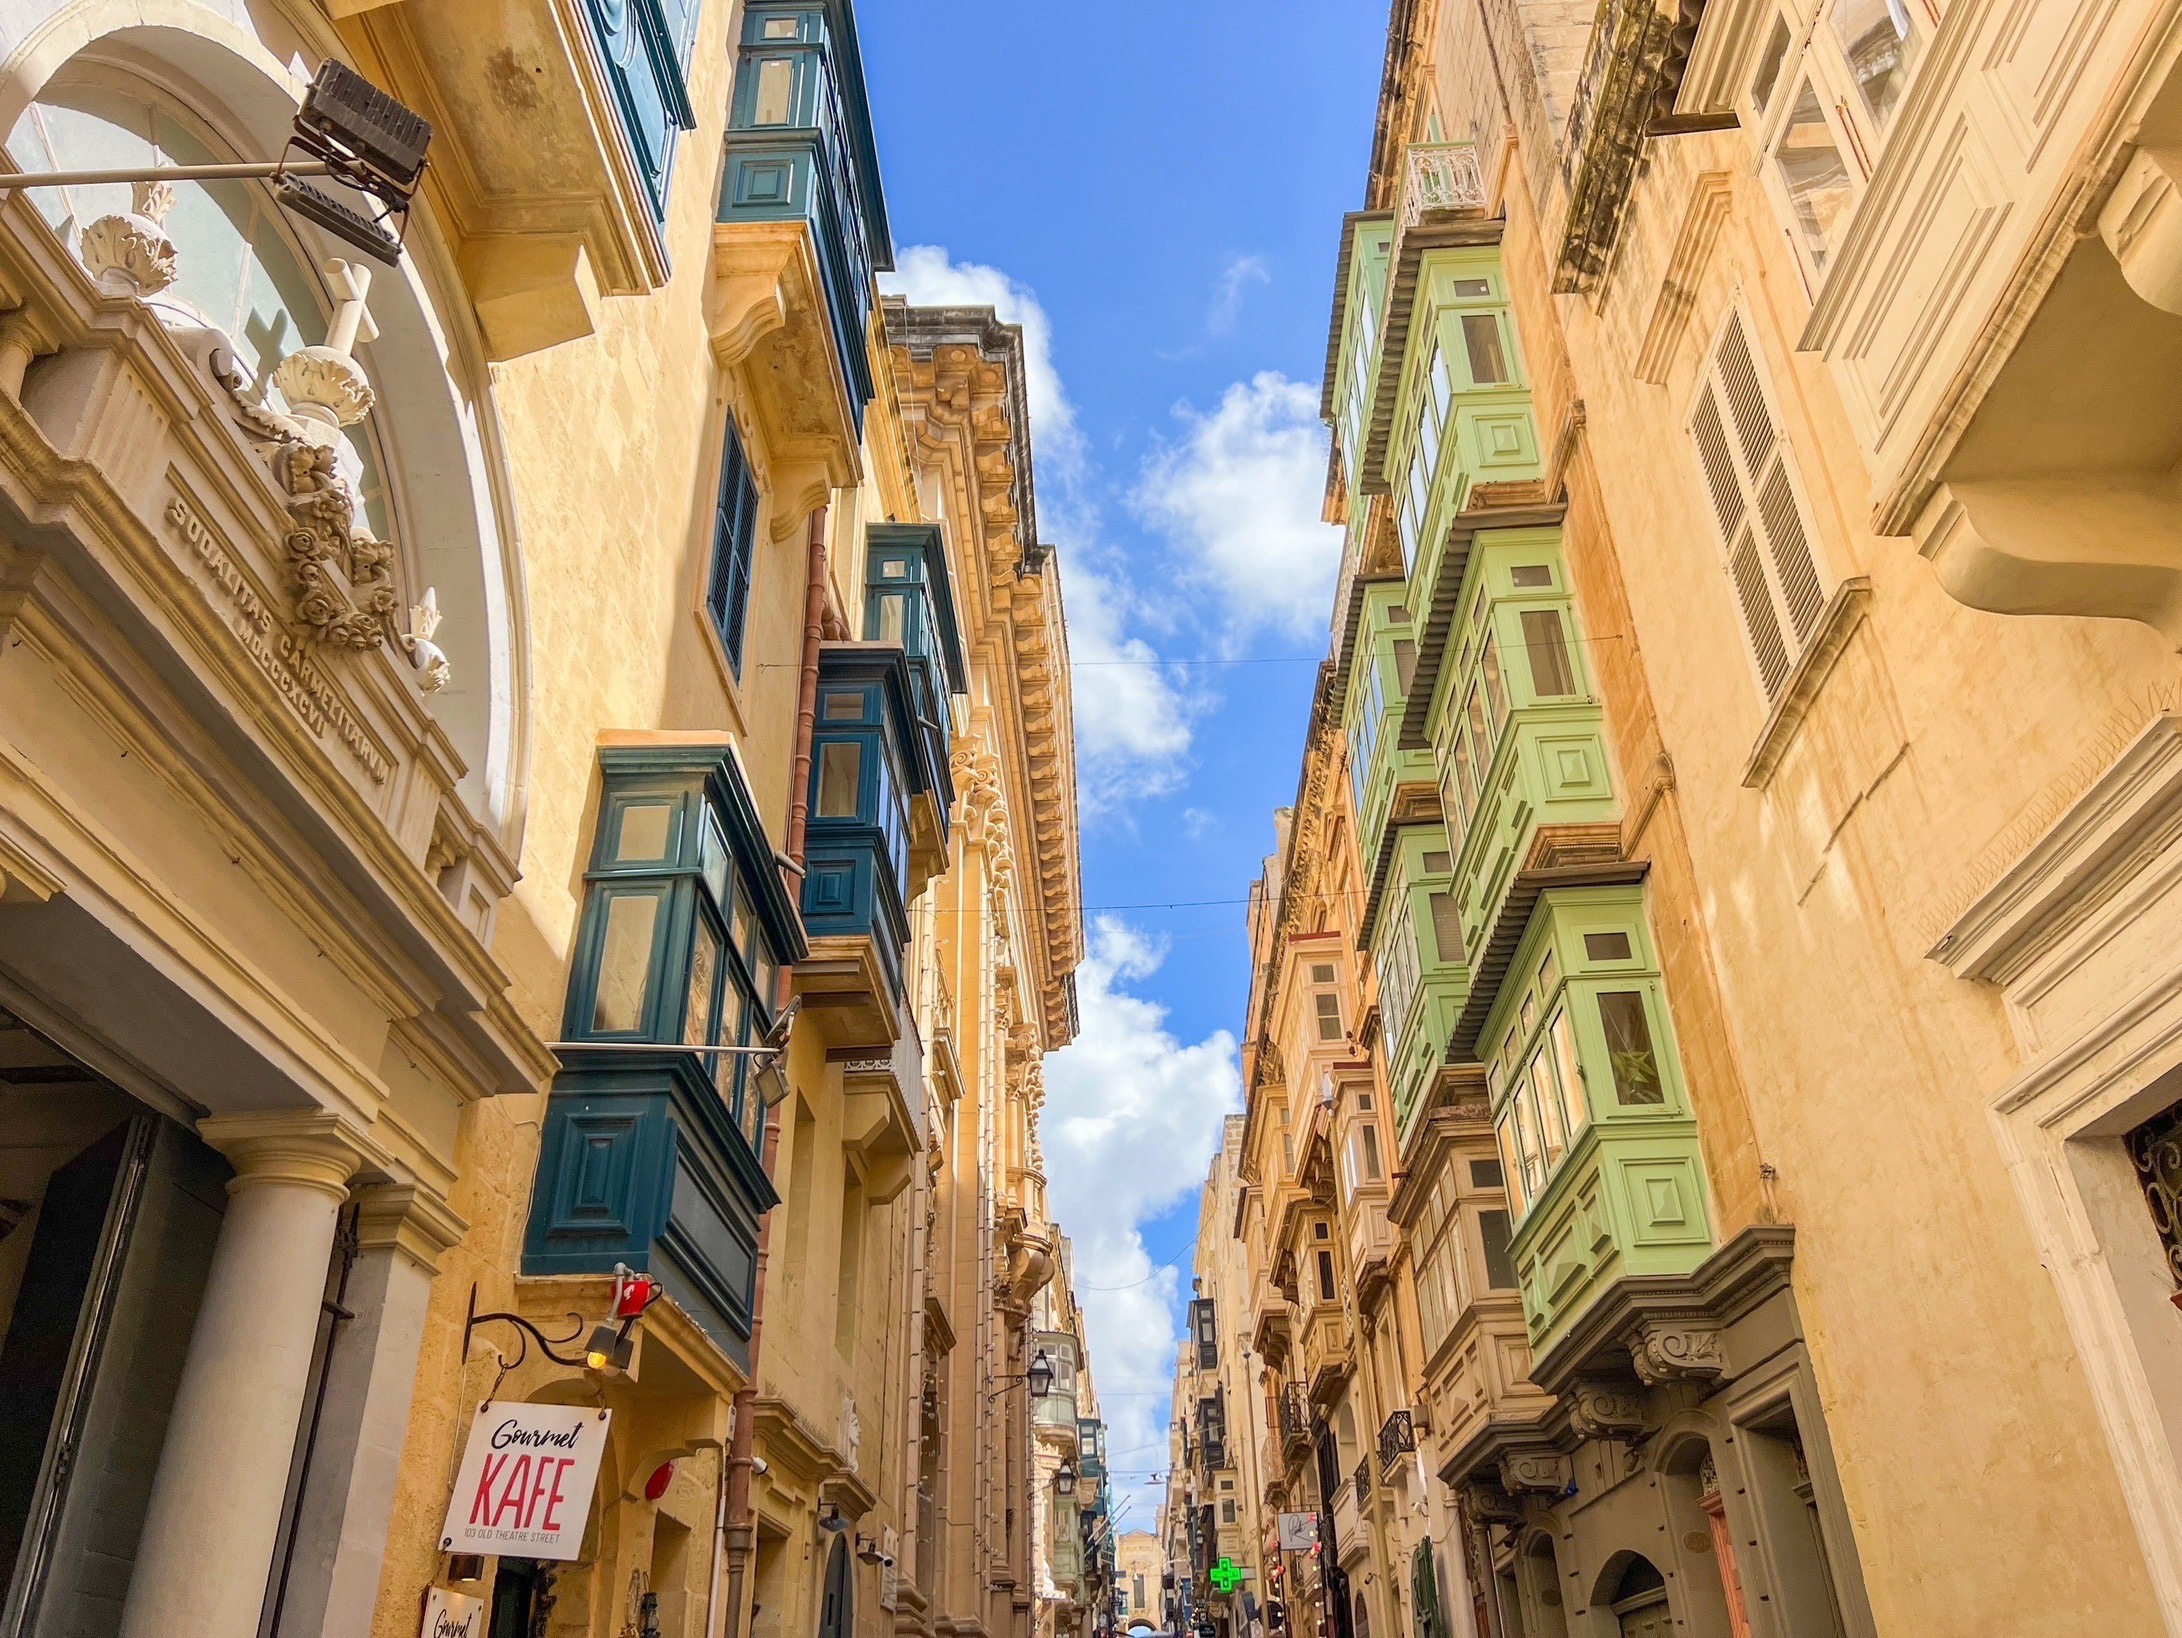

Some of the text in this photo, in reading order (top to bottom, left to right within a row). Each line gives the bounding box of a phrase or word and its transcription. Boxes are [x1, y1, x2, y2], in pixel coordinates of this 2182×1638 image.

[170, 496, 274, 633] SODALITAS
[490, 1419, 584, 1450] Gourmet
[469, 1453, 575, 1531] KAFE
[464, 1528, 560, 1543] 103 OLD THEATRE STREET
[433, 1608, 472, 1638] Gourmet
